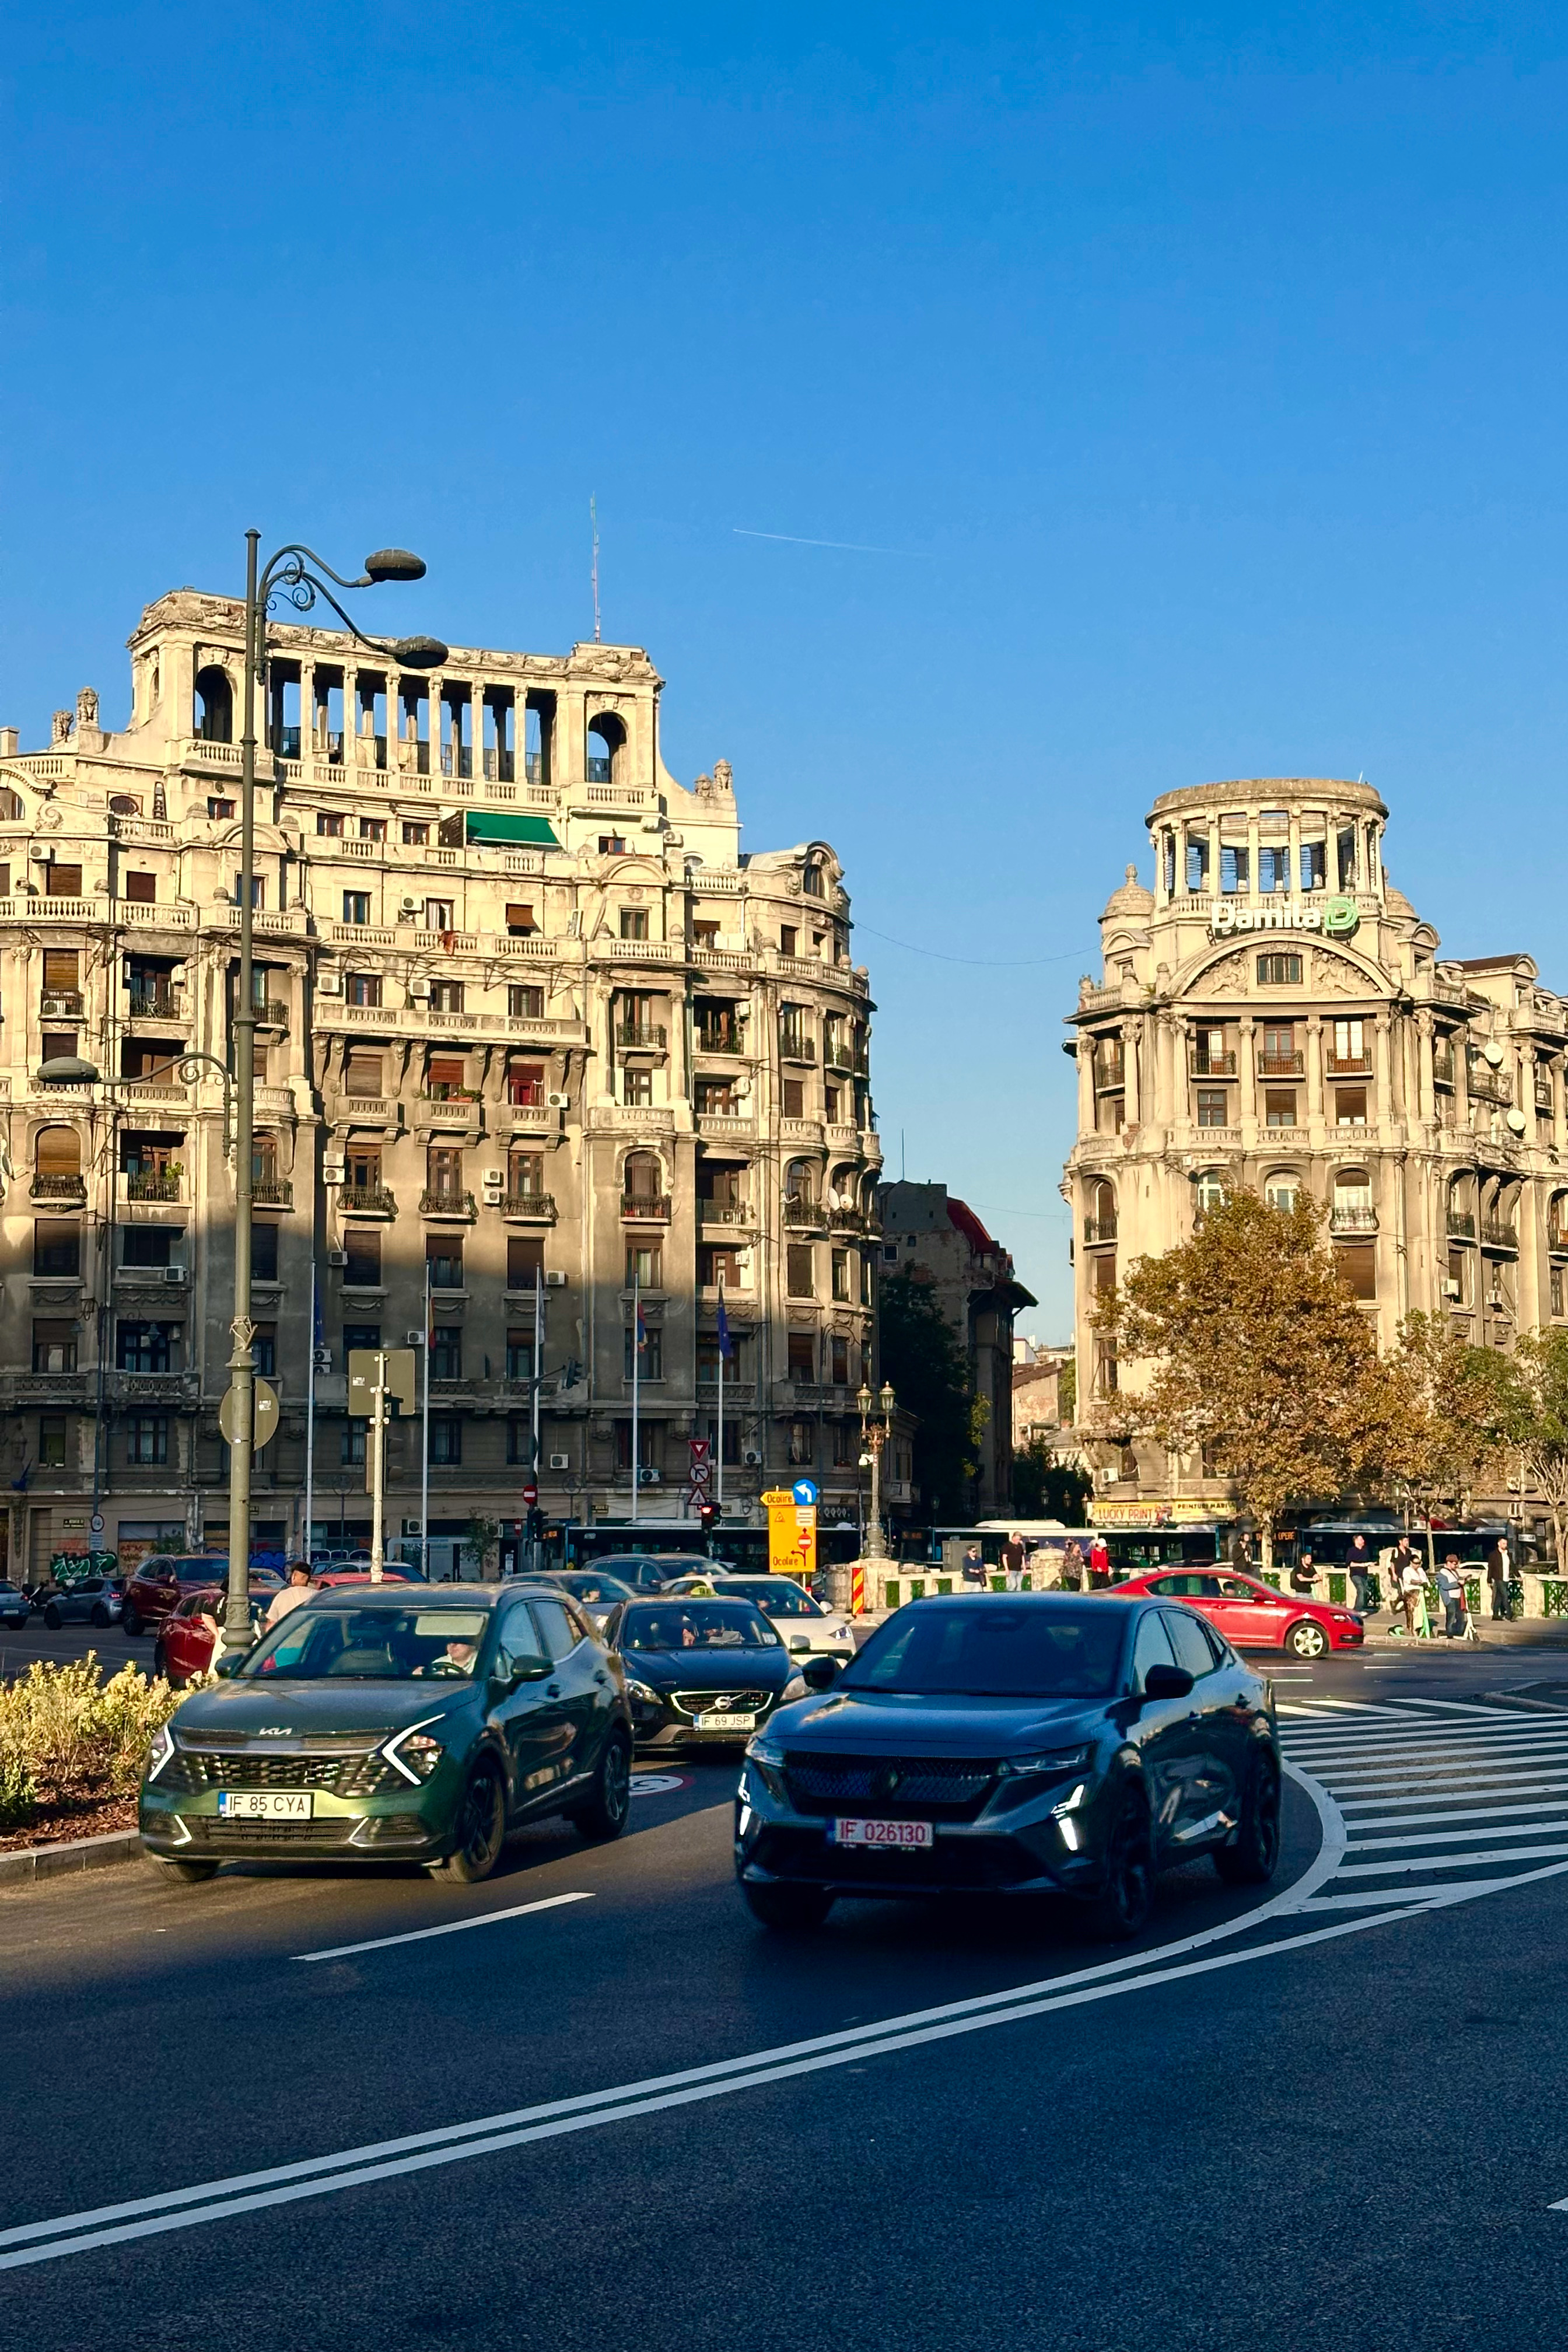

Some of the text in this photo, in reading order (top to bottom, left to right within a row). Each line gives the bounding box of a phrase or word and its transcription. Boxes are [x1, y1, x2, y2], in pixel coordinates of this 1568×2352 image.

[1212, 901, 1321, 928] Damila
[766, 1494, 792, 1503] Ocolire
[1098, 1508, 1153, 1520] LUCKY PRINT
[773, 1556, 799, 1566] Ocolire
[702, 1716, 750, 1726] IF 69 JSP
[230, 1796, 305, 1812] IF 85 CYA
[841, 1821, 925, 1843] IF 026130
